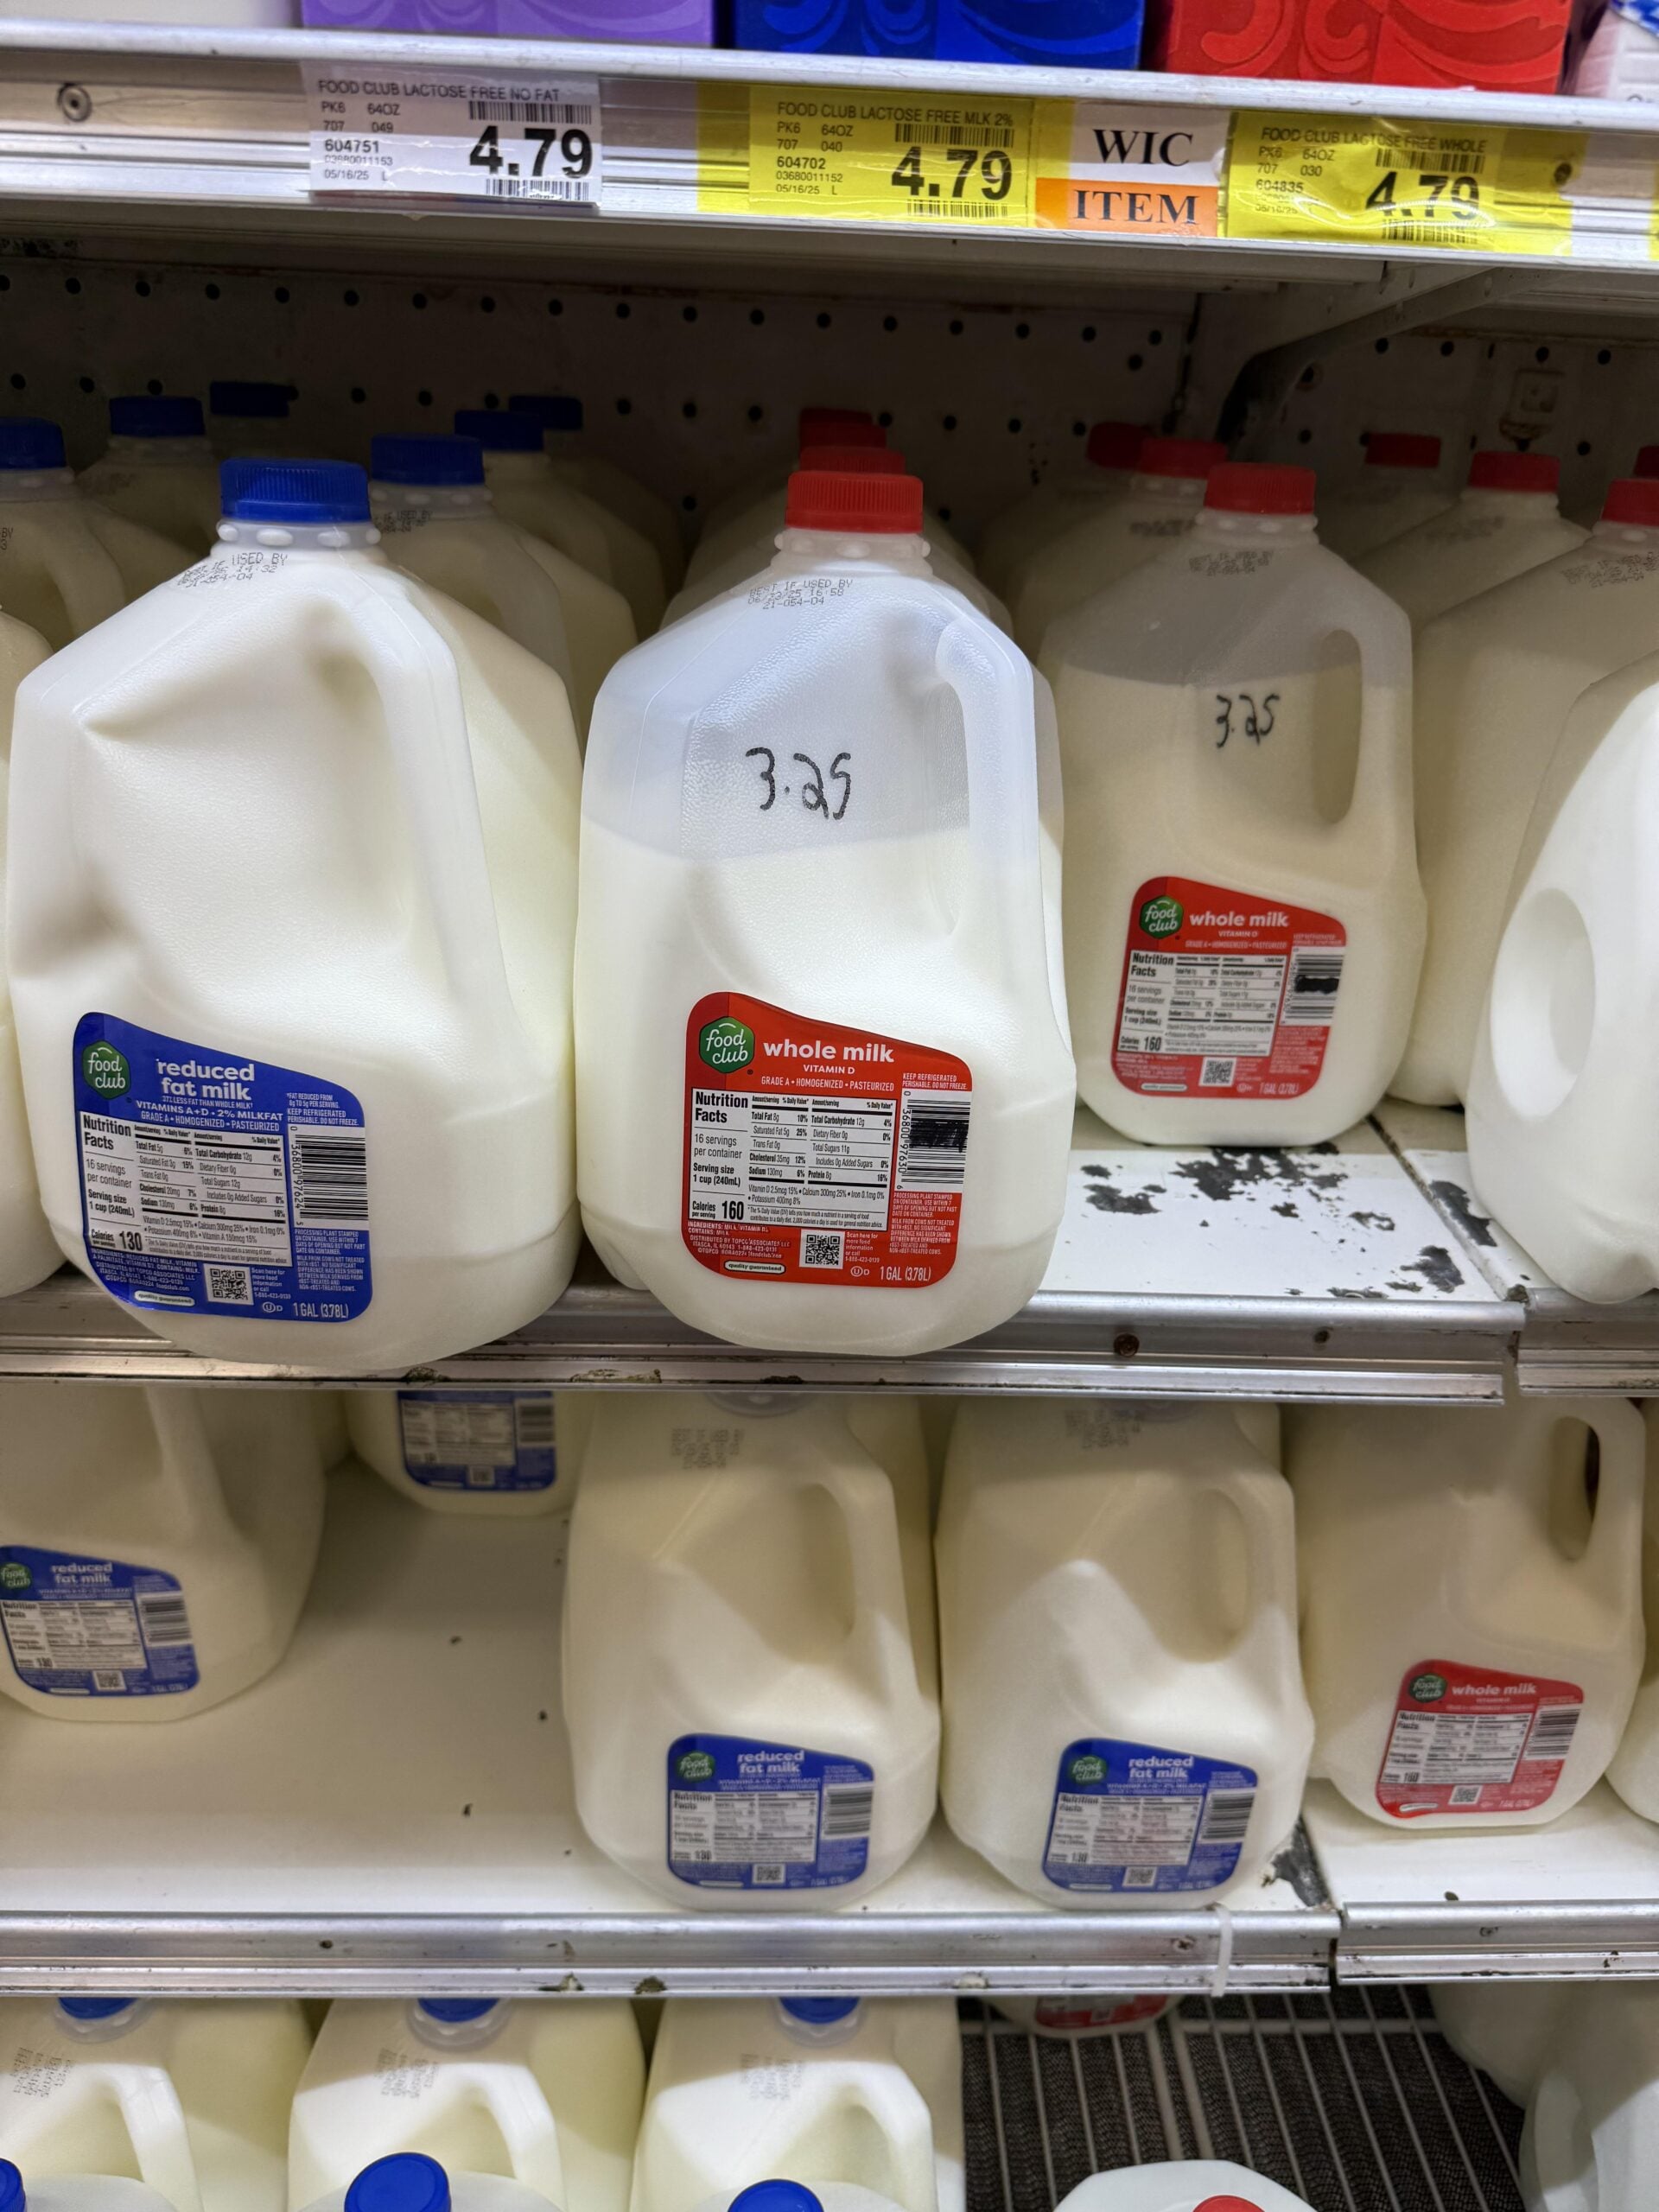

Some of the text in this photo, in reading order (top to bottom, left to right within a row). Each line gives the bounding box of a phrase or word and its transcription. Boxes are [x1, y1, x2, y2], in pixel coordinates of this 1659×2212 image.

[318, 80, 559, 102] FOOD CLUB LACTOSE FREE NO FAT
[321, 101, 401, 116] PK6 64OZ
[778, 102, 1014, 126] FOOD CLUB LACTOSE FREE MLK 2%
[323, 120, 345, 131] 707
[777, 121, 854, 137] PK6 64OZ
[324, 138, 379, 153] 604751
[777, 138, 843, 152] 707 040
[1262, 128, 1486, 153] FOOD CLUB LACTOSE FREE WHOLE
[469, 125, 593, 179] 4.79
[1093, 130, 1192, 167] WIC
[1302, 149, 1335, 161] 64OZ
[777, 156, 826, 169] 604702
[1258, 162, 1323, 176] 707 030
[324, 169, 370, 181] 05/16/25
[776, 170, 843, 183] 03680011152
[892, 146, 1012, 200] 4.79
[776, 184, 837, 195] 05/16/25 L
[1365, 172, 1479, 220] 4.79
[1074, 189, 1198, 225] ITEM
[804, 579, 831, 588] USED
[839, 579, 853, 588] BY
[746, 747, 852, 820] 3.25
[1145, 902, 1177, 923] food
[1189, 911, 1288, 927] whole milk
[1148, 916, 1179, 932] club
[1132, 953, 1173, 966] Nutrition
[1130, 965, 1156, 977] Facts
[706, 1028, 747, 1052] food
[1143, 1037, 1161, 1052] 160
[712, 1046, 748, 1064] club
[763, 1039, 894, 1063] whole milk
[87, 1052, 123, 1074] food
[156, 1059, 255, 1082] reduced
[804, 1064, 855, 1075] VITAMIN D
[95, 1072, 125, 1089] club
[761, 1076, 894, 1091] GRADE A HOMOGENIZED PASTEURIZED
[917, 1073, 957, 1083] REFRIGERATED
[162, 1077, 251, 1101] fat milk
[696, 1091, 748, 1109] Nutrition
[136, 1100, 283, 1122] VITAMINS A+D 2% MILKFAT
[695, 1108, 728, 1123] Facts
[752, 1111, 764, 1121] Total
[772, 1113, 779, 1122] 8g
[83, 1115, 131, 1137] Nutrition
[141, 1110, 280, 1132] GRADE A HOMOGENIZED PASTEURIZED
[798, 1115, 808, 1123] 10%
[824, 1116, 855, 1126] Carbohydrate
[856, 1117, 865, 1127] 12g
[883, 1119, 892, 1128] 4%
[753, 1126, 775, 1135] Saturated
[783, 1127, 790, 1137] 5g
[797, 1128, 807, 1137] 25%
[84, 1132, 114, 1150] Facts
[695, 1134, 737, 1147] 16 servings
[694, 1147, 742, 1159] per container
[749, 1153, 790, 1165] Cholesterol 35mg
[795, 1155, 806, 1164] 12%
[86, 1159, 126, 1176] 16 servings
[693, 1162, 734, 1175] Serving size
[87, 1173, 132, 1189] per container
[699, 1176, 712, 1185] cup
[713, 1175, 741, 1187] (240mL)
[88, 1189, 127, 1204] Serving size
[89, 1201, 135, 1218] 1 cup (240mL)
[692, 1200, 745, 1220] Calories 160
[91, 1229, 143, 1251] Calories 130
[880, 1266, 931, 1281] 1 GAL (3.78L)
[293, 1302, 298, 1317] 1
[300, 1302, 319, 1318] GAL
[51, 1562, 113, 1573] reduced
[54, 1573, 111, 1584] fat milk
[1452, 1683, 1537, 1695] whole milk
[737, 1750, 804, 1763] reduced
[1128, 1756, 1194, 1768] reduced
[740, 1762, 801, 1774] fat milk
[1128, 1767, 1188, 1779] fat milk
